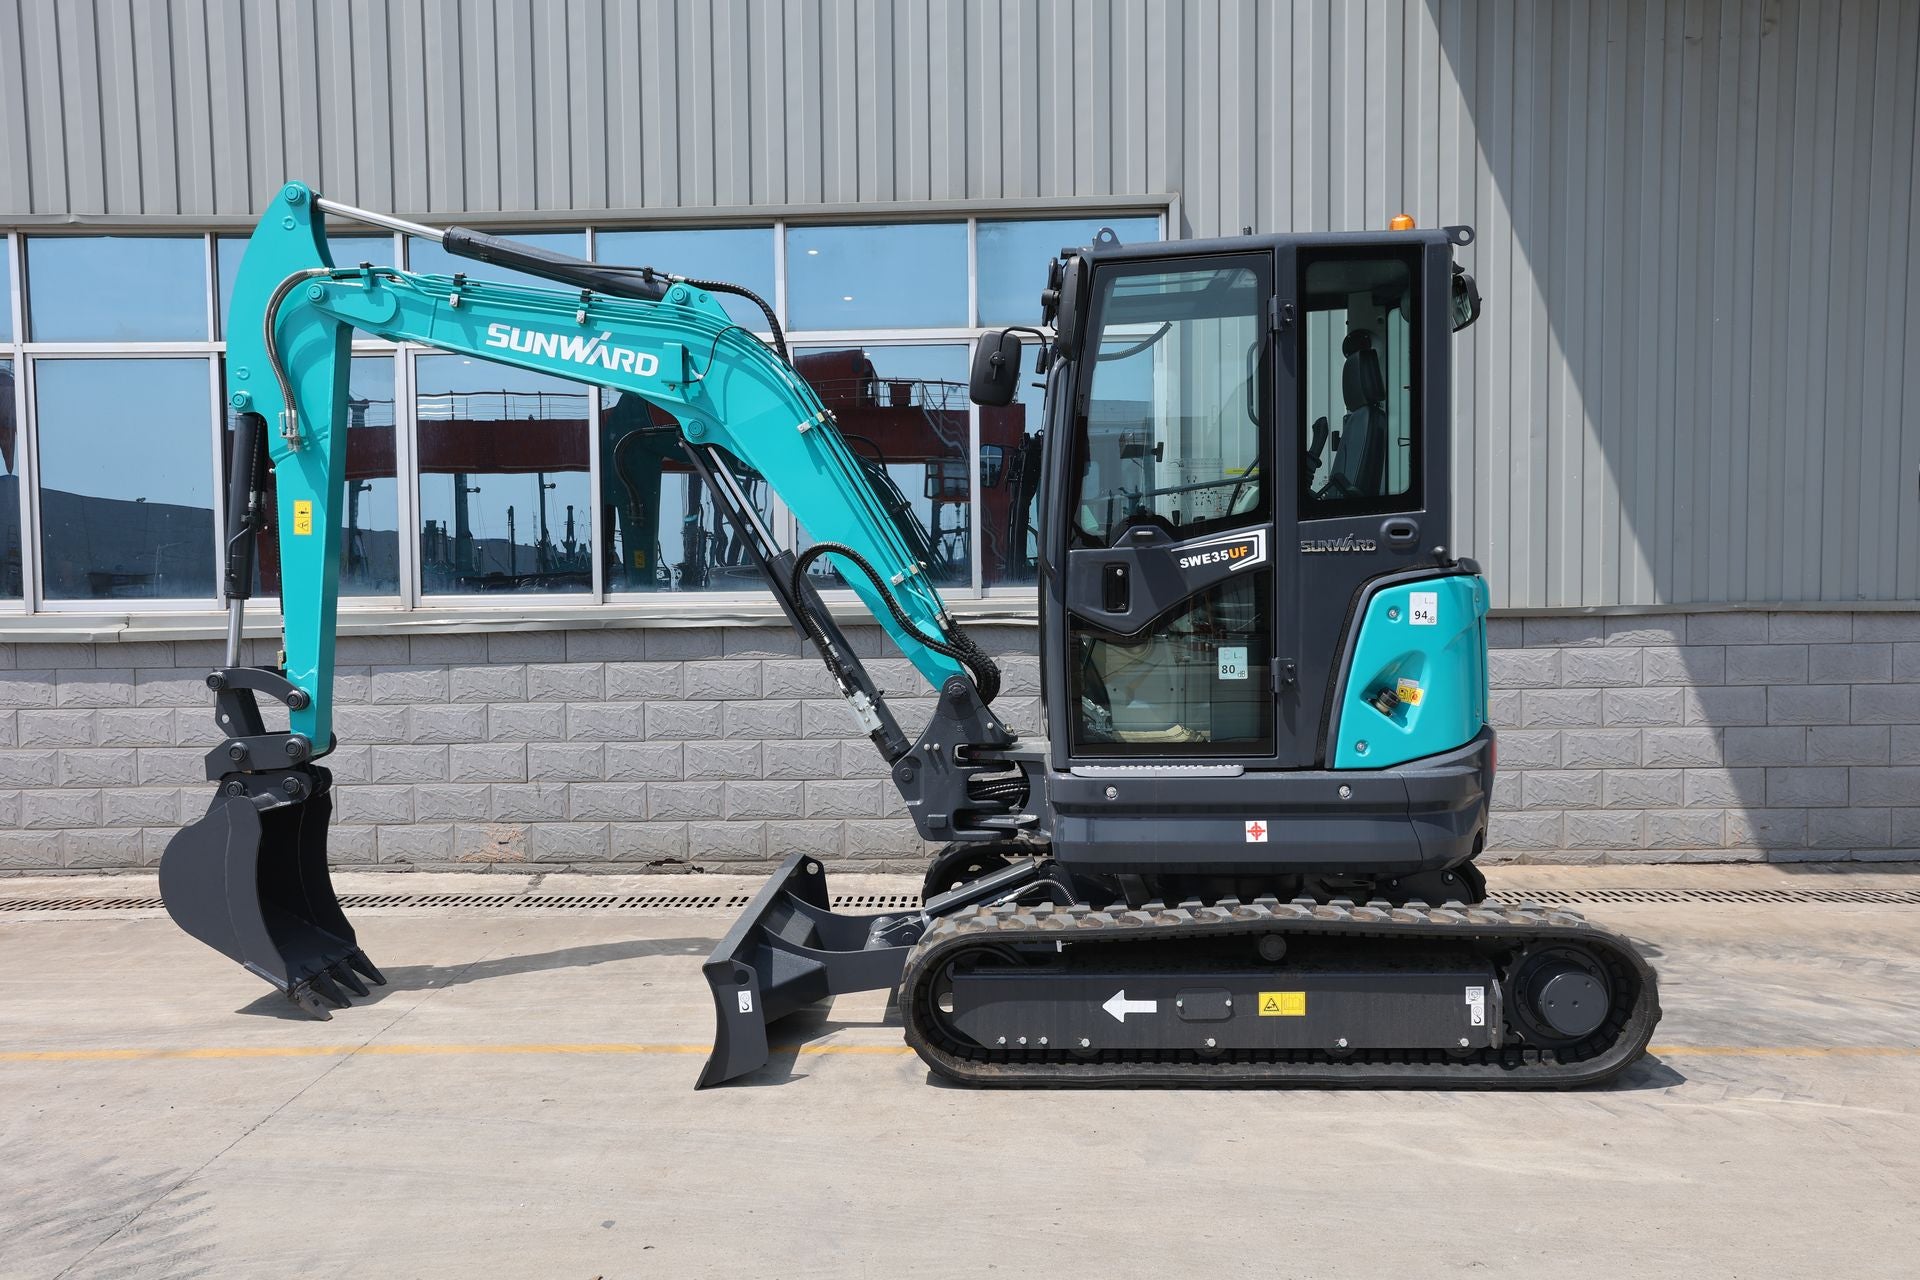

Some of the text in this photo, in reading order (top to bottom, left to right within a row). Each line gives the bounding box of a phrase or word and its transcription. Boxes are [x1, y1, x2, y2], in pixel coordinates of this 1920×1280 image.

[485, 322, 660, 377] SUNWARD
[1300, 533, 1377, 552] SUNWARD
[1179, 545, 1248, 569] SWE35UF
[1414, 610, 1428, 620] 94
[1221, 664, 1246, 678] 80 dB
